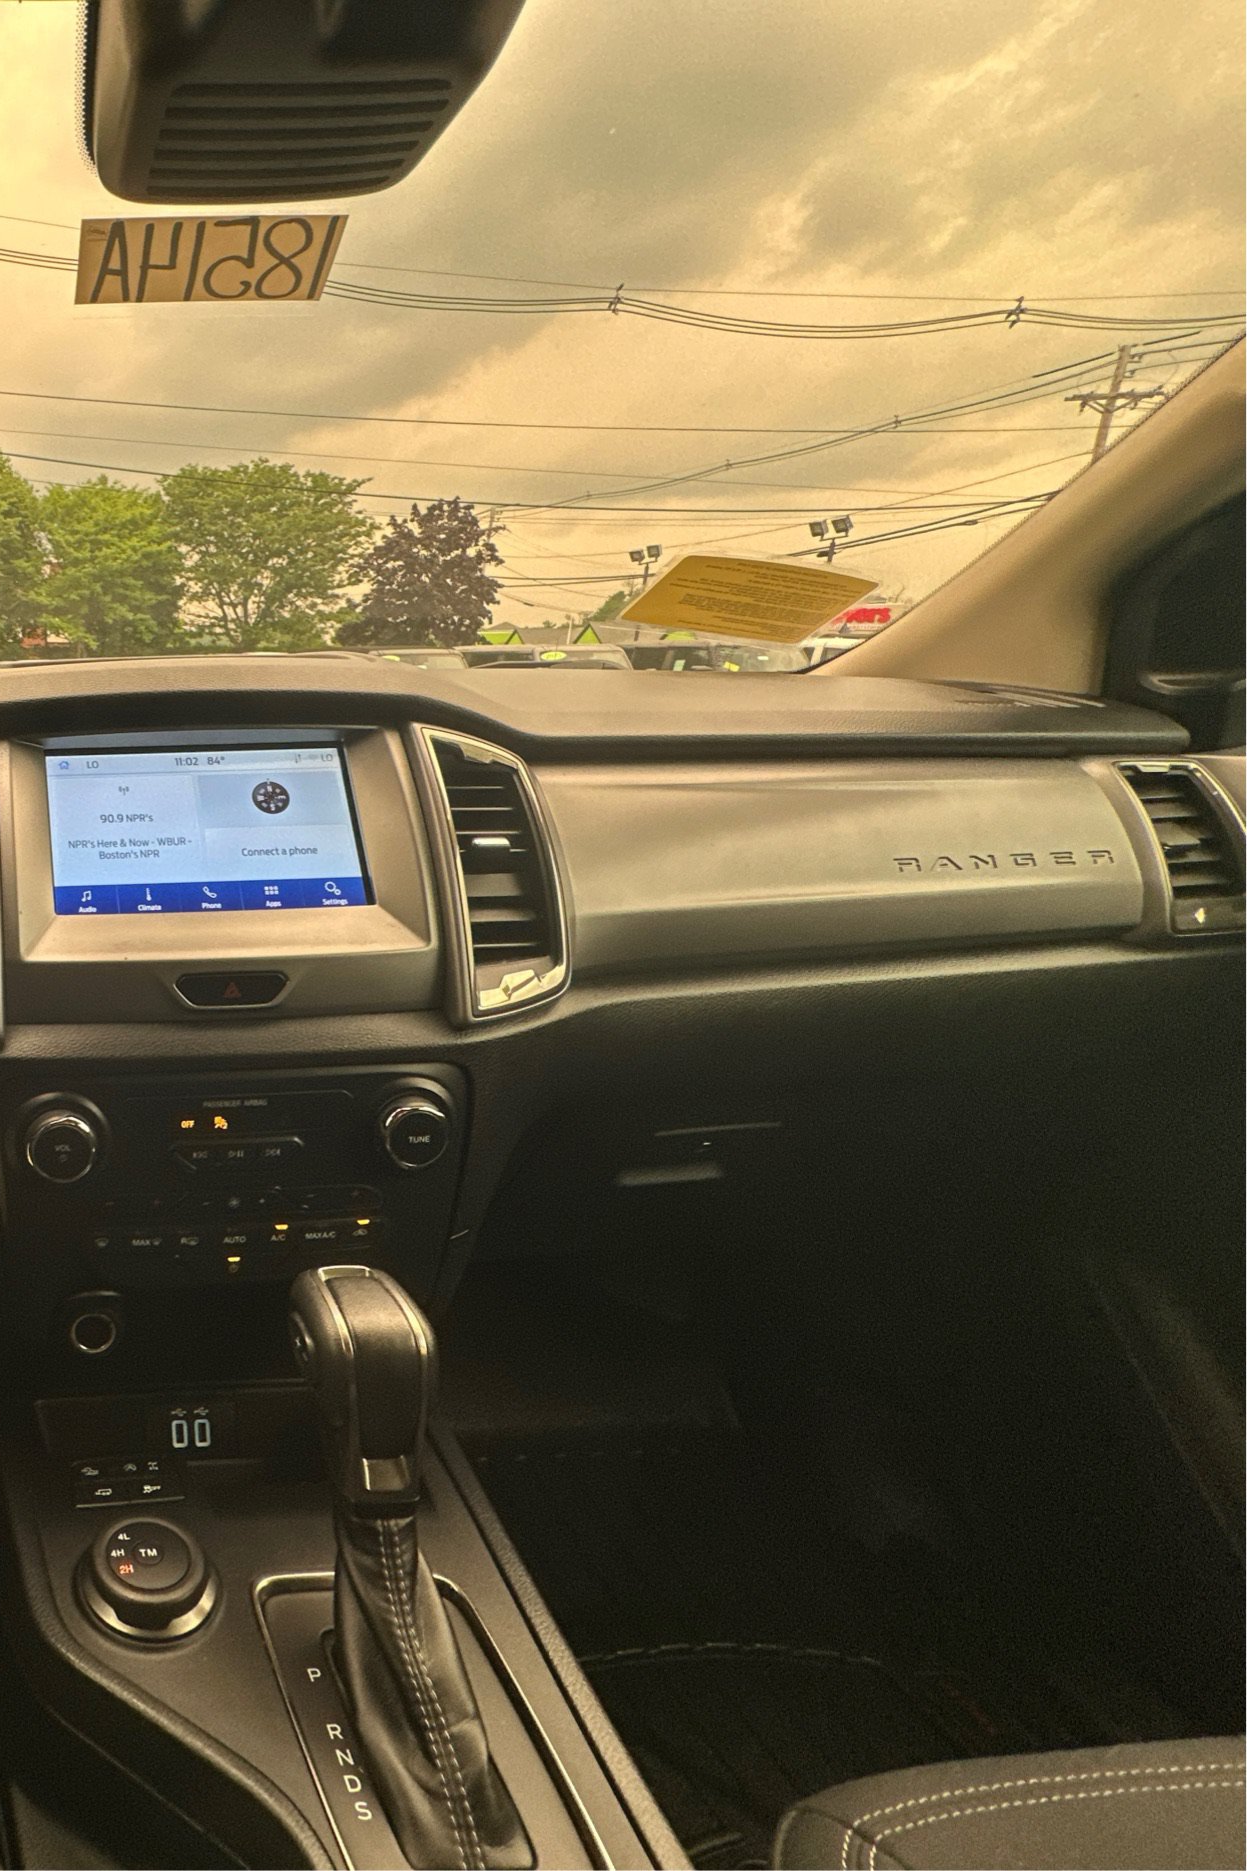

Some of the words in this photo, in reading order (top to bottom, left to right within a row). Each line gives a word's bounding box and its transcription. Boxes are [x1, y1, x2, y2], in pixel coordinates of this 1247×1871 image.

[86, 760, 99, 769] LO
[174, 756, 199, 767] 11:02
[206, 756, 226, 766] 84°
[99, 813, 124, 824] 90.9
[125, 812, 154, 823] NPR's
[67, 839, 95, 849] NPR's
[96, 838, 117, 848] Here
[119, 838, 127, 848] &
[128, 837, 150, 847] Now
[157, 836, 187, 847] WBUR
[98, 849, 139, 860] Boston's
[139, 849, 160, 859] NPR
[241, 847, 280, 857] Connect
[281, 848, 287, 856] a
[288, 846, 318, 857] phone
[893, 849, 1116, 873] RANGER
[201, 902, 222, 910] Phone
[265, 900, 282, 908] Apps
[322, 897, 349, 906] Settings
[78, 906, 98, 914] Audio
[137, 904, 162, 912] Climate
[180, 1119, 195, 1130] OFF
[408, 1134, 431, 1145] TUNE
[131, 1237, 151, 1247] MAX
[222, 1235, 247, 1245] AUTO
[270, 1233, 287, 1242] A/C
[117, 1532, 131, 1542] 4L
[110, 1549, 126, 1558] 4H
[138, 1548, 158, 1558] TM
[118, 1564, 134, 1575] 2H
[306, 1667, 322, 1682] P
[326, 1723, 344, 1740] R
[335, 1748, 355, 1767] N
[343, 1774, 362, 1793] D
[354, 1801, 373, 1821] S
